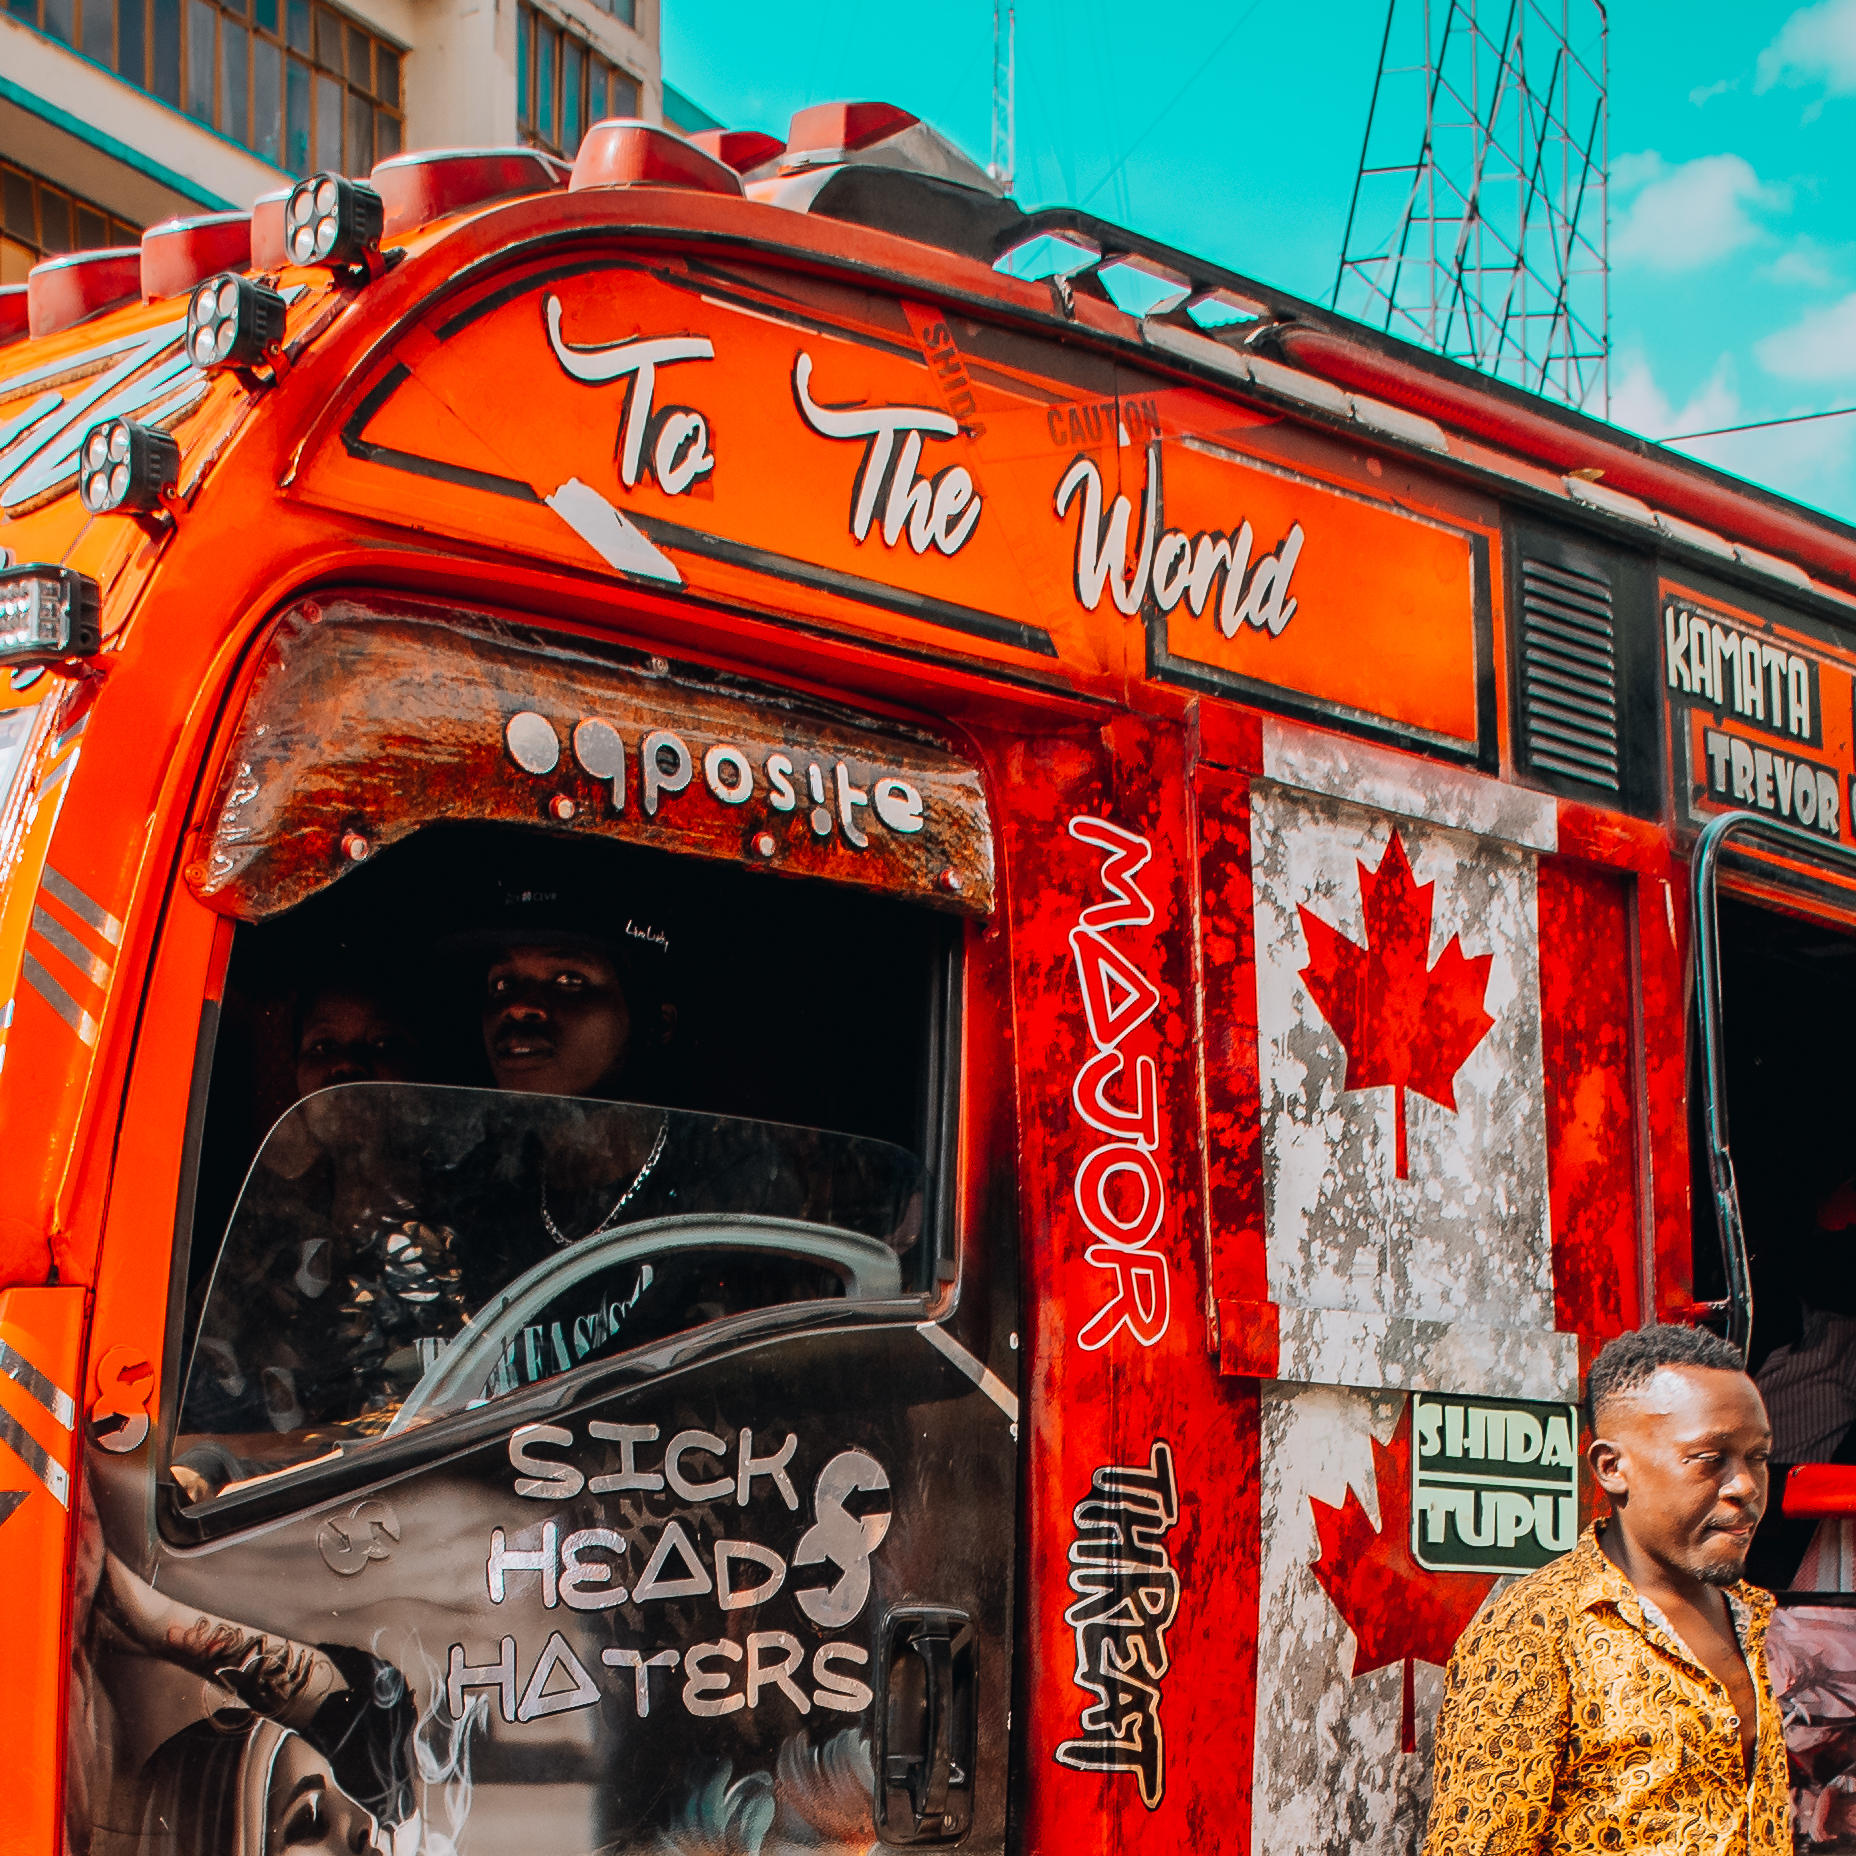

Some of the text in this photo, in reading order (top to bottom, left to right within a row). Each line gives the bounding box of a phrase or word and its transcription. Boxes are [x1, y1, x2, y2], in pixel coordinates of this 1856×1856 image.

[546, 294, 1304, 639] To The World
[1047, 400, 1162, 446] CAUTION
[1665, 605, 1812, 739] KAMATA
[1707, 730, 1840, 834] TREVOR
[1067, 814, 1173, 1351] MAJOR
[507, 1422, 800, 1507] SICK
[1417, 1402, 1573, 1467] SHIDA
[1418, 1484, 1572, 1549] TUPU
[1055, 1440, 1181, 1811] THREAT
[446, 1630, 875, 1724] HATERS
